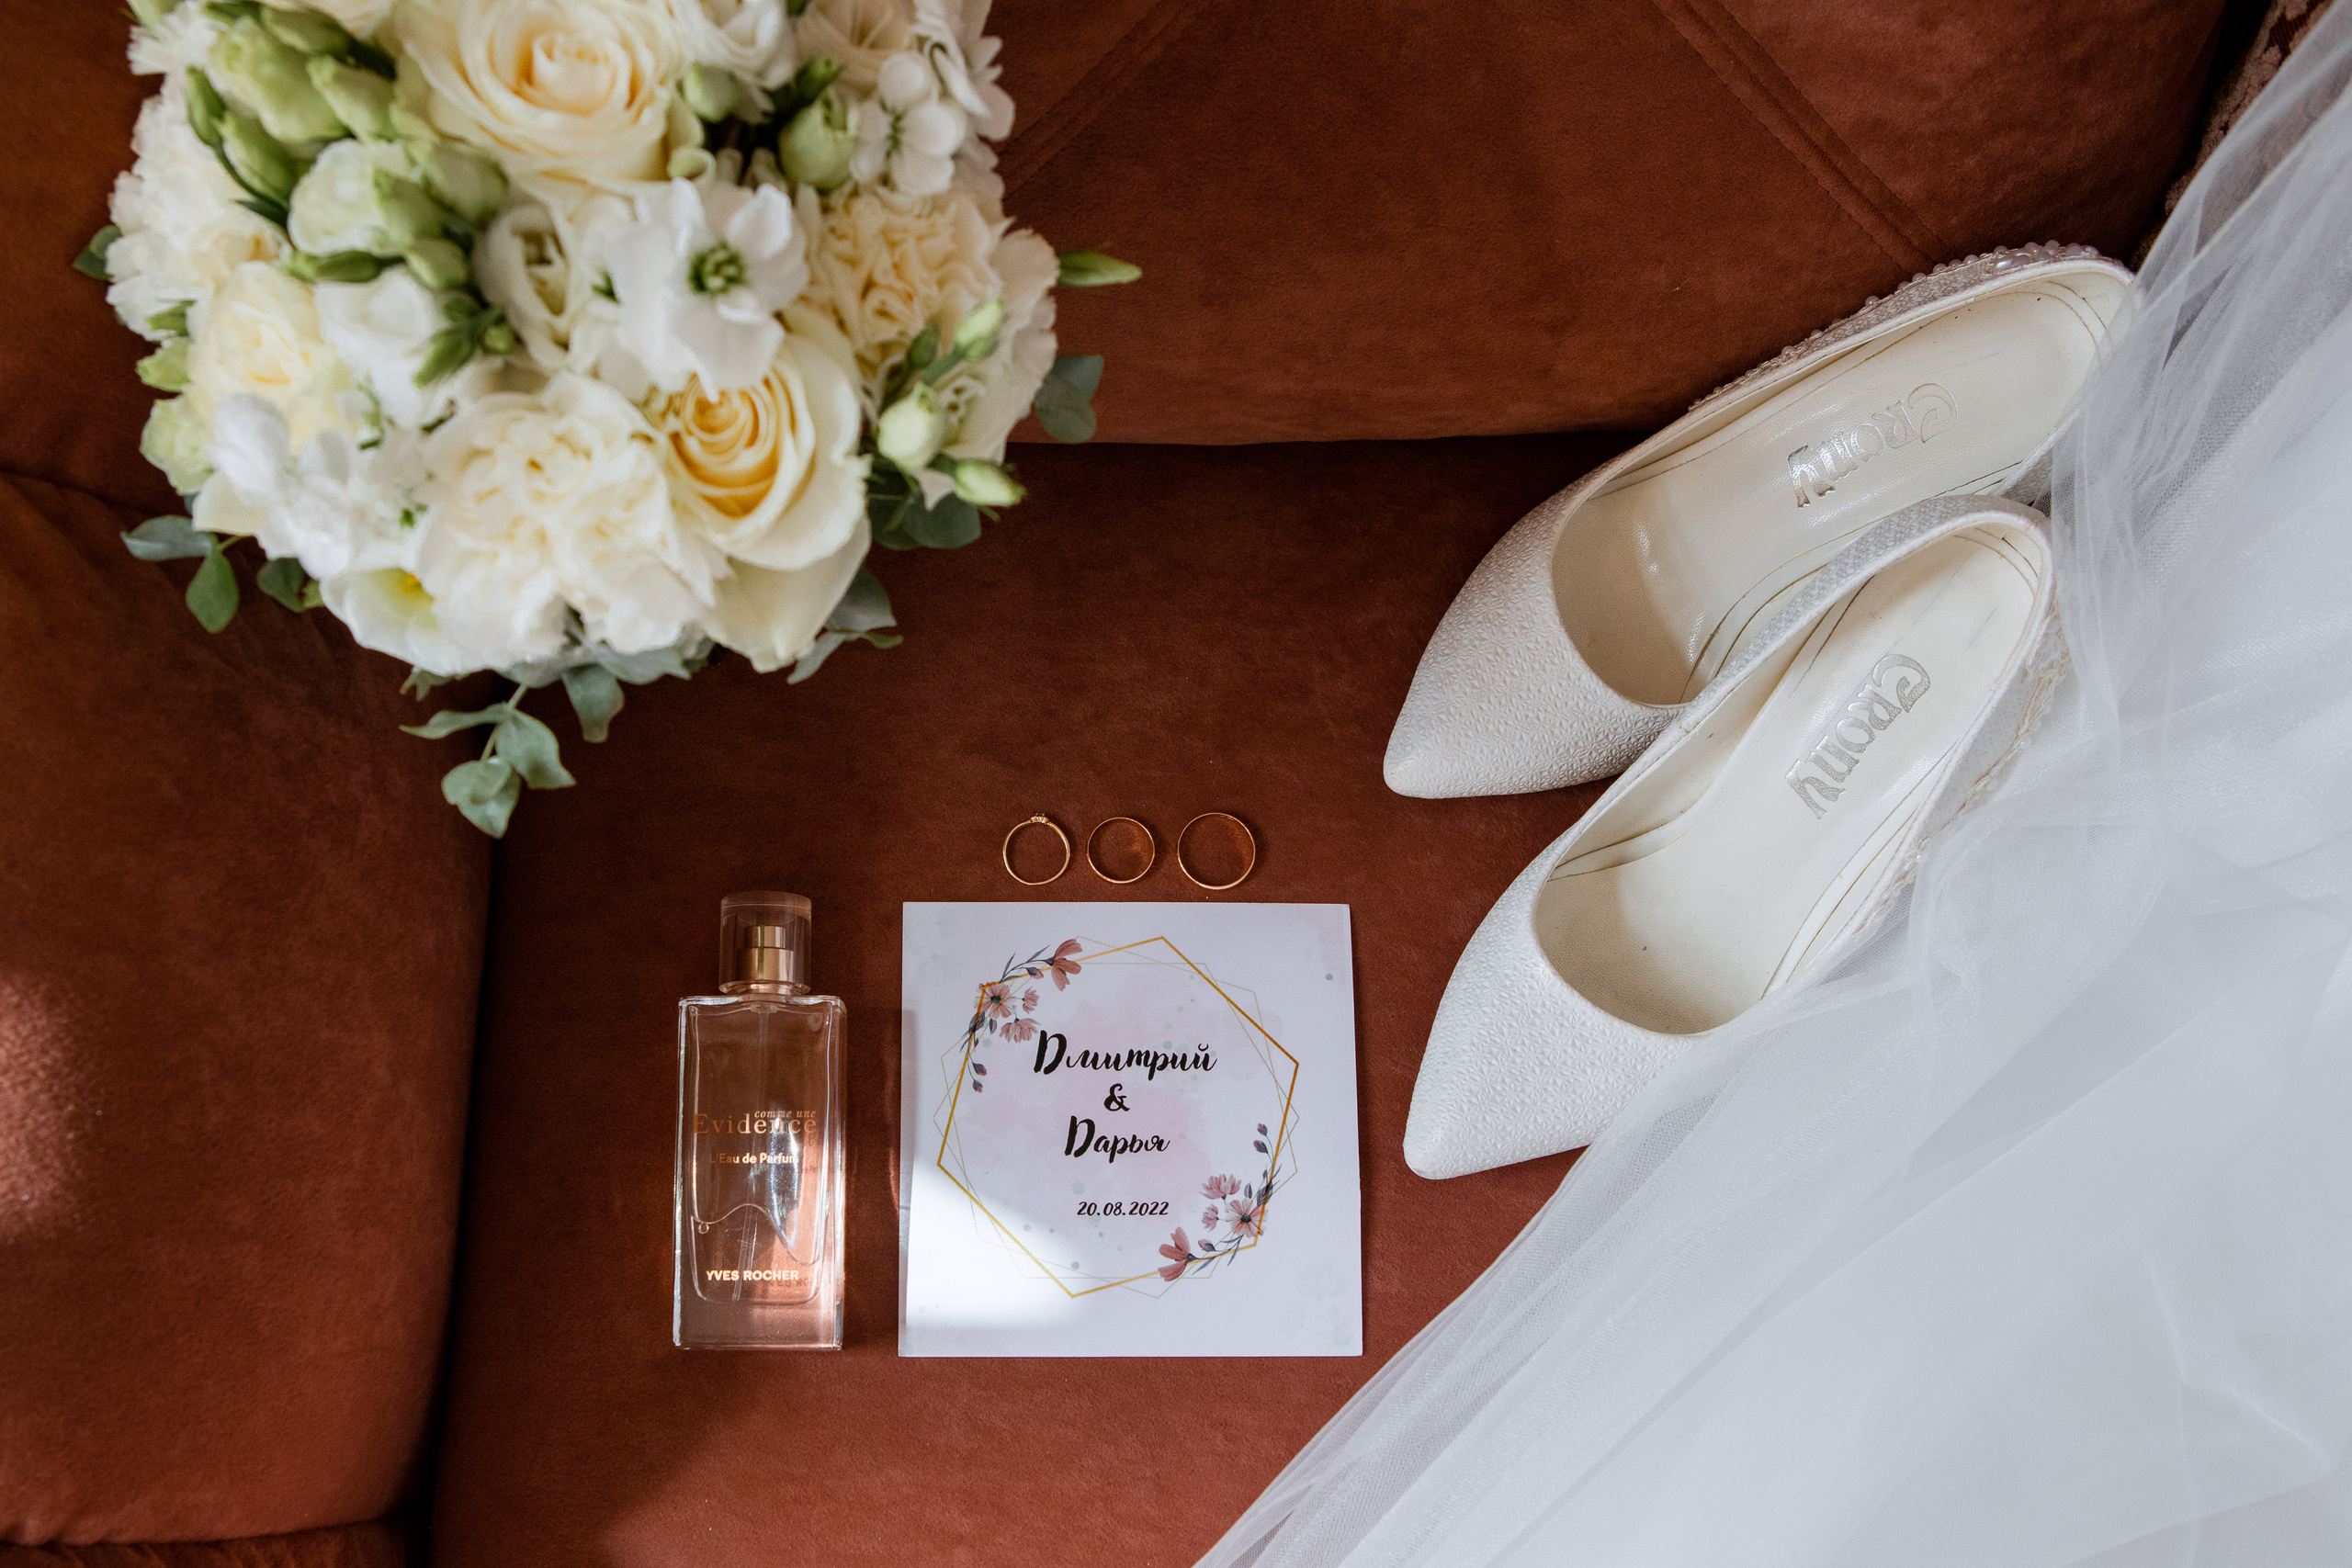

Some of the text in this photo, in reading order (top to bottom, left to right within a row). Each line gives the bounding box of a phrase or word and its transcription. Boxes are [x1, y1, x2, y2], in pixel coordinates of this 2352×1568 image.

[1033, 1030, 1218, 1081] Дмитрий
[1103, 1083, 1130, 1111] &
[693, 1113, 818, 1134] Evidence
[753, 1110, 817, 1119] comme une
[1064, 1115, 1171, 1164] Дарья
[741, 1152, 757, 1164] de
[759, 1152, 799, 1164] Parfum
[1077, 1201, 1170, 1216] 20.08.2022
[706, 1269, 799, 1281] YVES ROCHER
